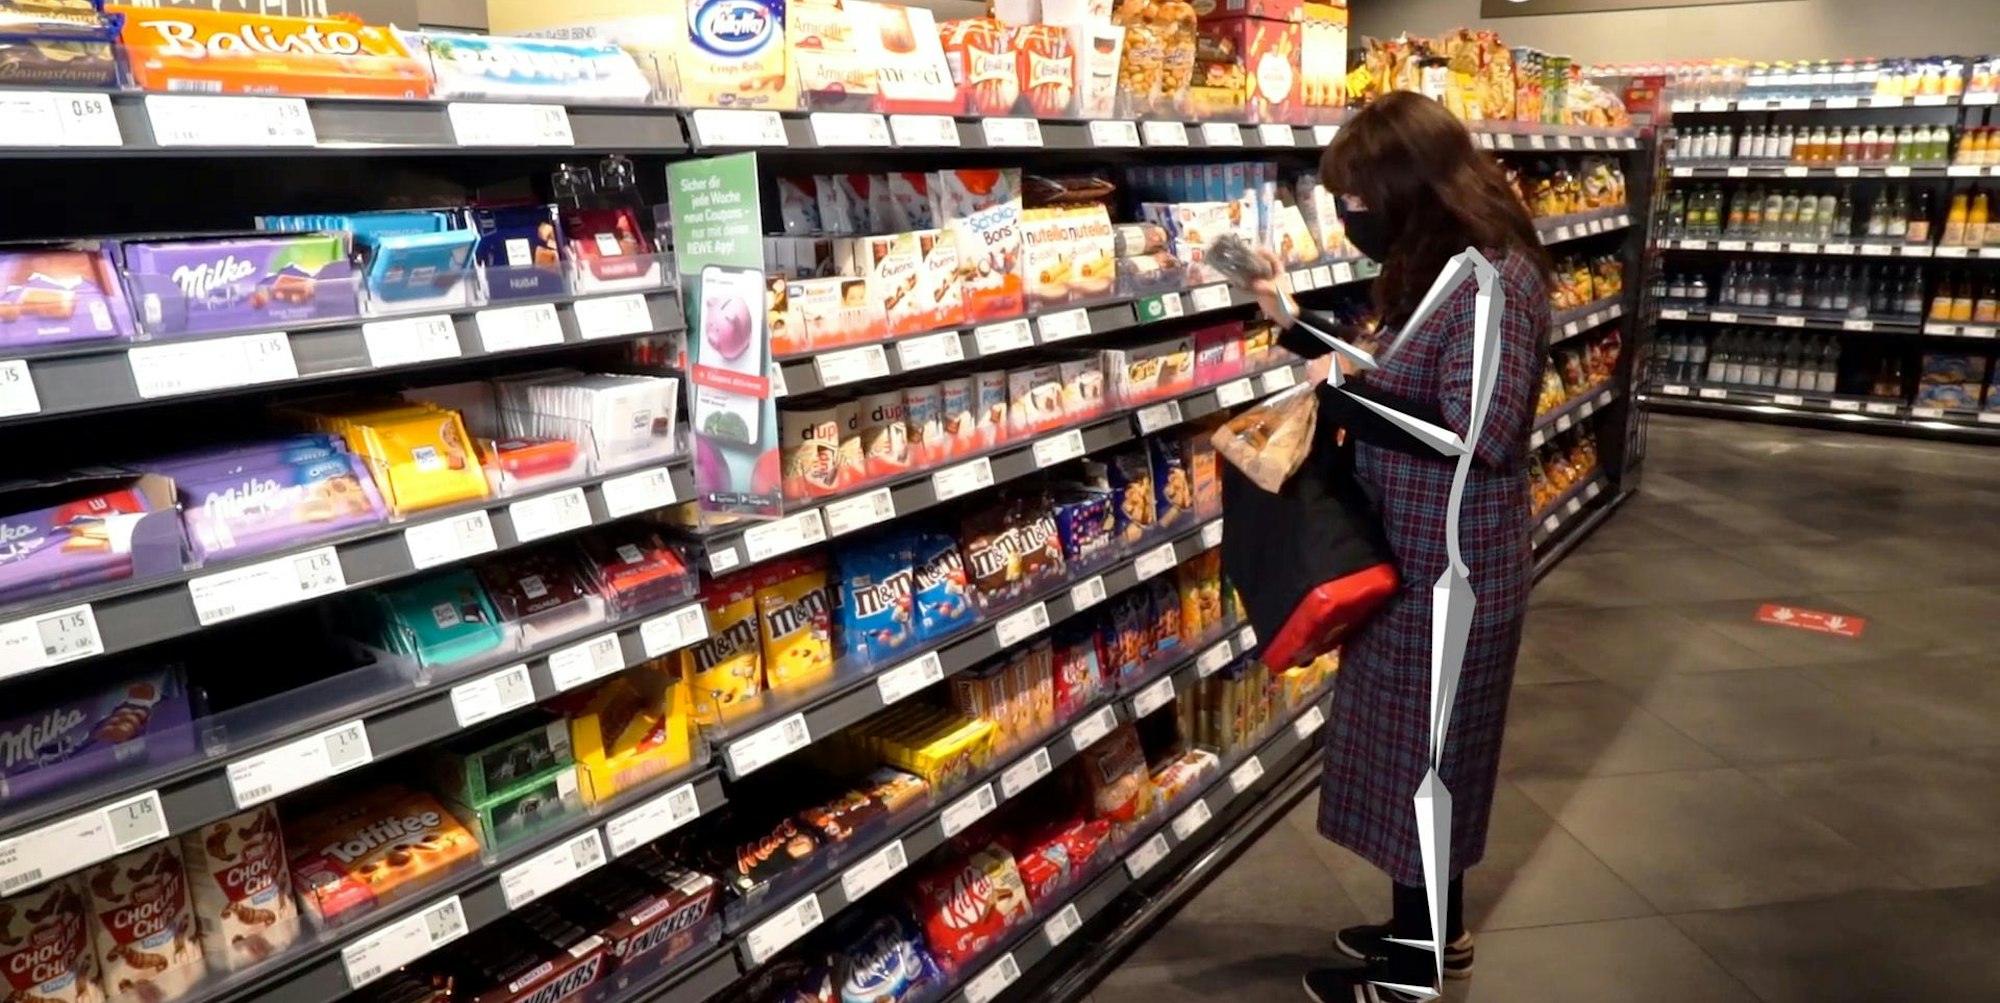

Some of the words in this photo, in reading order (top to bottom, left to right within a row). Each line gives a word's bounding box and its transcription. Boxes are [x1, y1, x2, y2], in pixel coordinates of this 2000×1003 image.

[140, 19, 361, 58] Balisto
[680, 177, 707, 192] Sicher
[691, 193, 710, 209] jede
[710, 190, 741, 205] Woche
[683, 211, 704, 224] neue
[984, 226, 1013, 247] Bons
[1026, 223, 1069, 245] nutella
[1068, 219, 1110, 241] nutella
[687, 240, 713, 255] REWE
[172, 255, 256, 300] Milka
[871, 405, 905, 432] dup
[801, 424, 838, 442] dup
[203, 477, 281, 518] Milka
[59, 614, 86, 632] 1.15
[0, 708, 87, 767] Milka
[340, 729, 359, 746] 1.15
[128, 800, 153, 821] 1.15
[320, 811, 442, 864] Toffifee
[941, 863, 994, 931] KitKat
[632, 898, 708, 957] SNICKERS
[522, 956, 599, 1003] NICKERS
